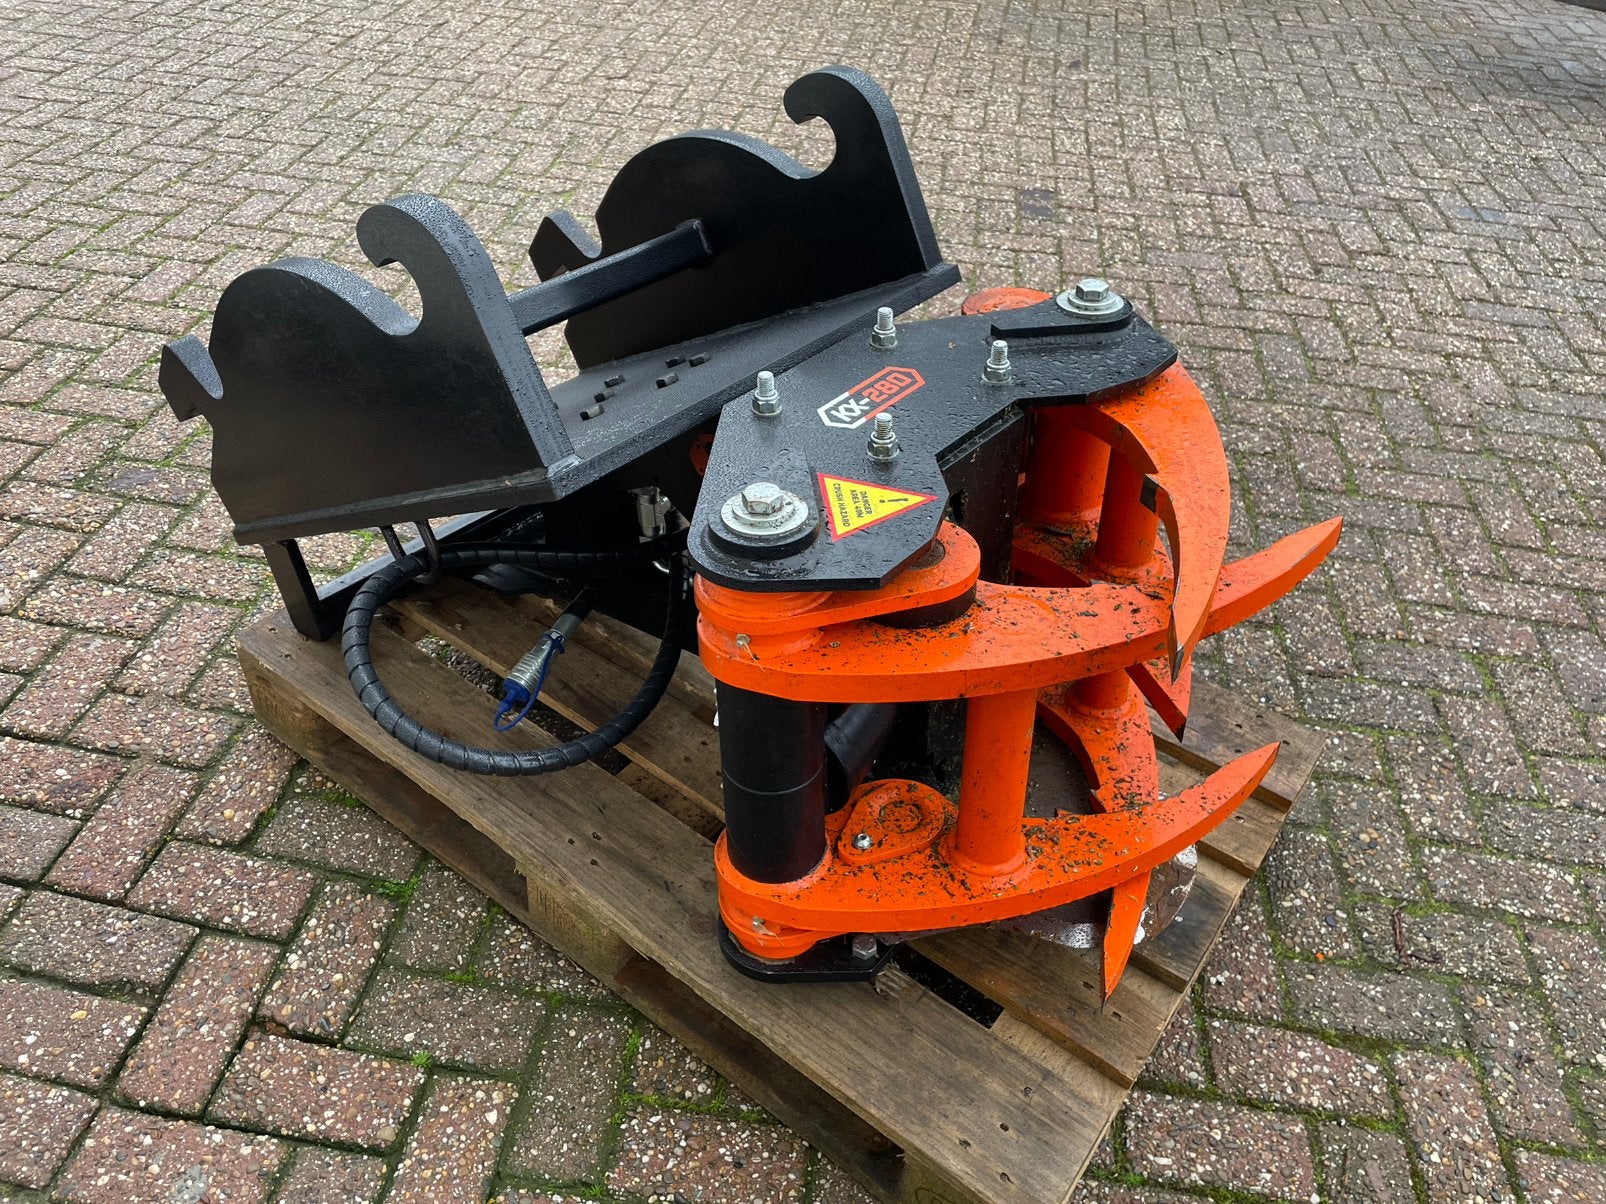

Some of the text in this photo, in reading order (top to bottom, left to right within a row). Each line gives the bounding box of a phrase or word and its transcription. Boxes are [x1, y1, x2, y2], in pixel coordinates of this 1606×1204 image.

[830, 372, 912, 421] KX-280
[833, 483, 850, 527] CRUSH HAZARD
[850, 489, 860, 505] AREA
[860, 491, 873, 515] DANGER
